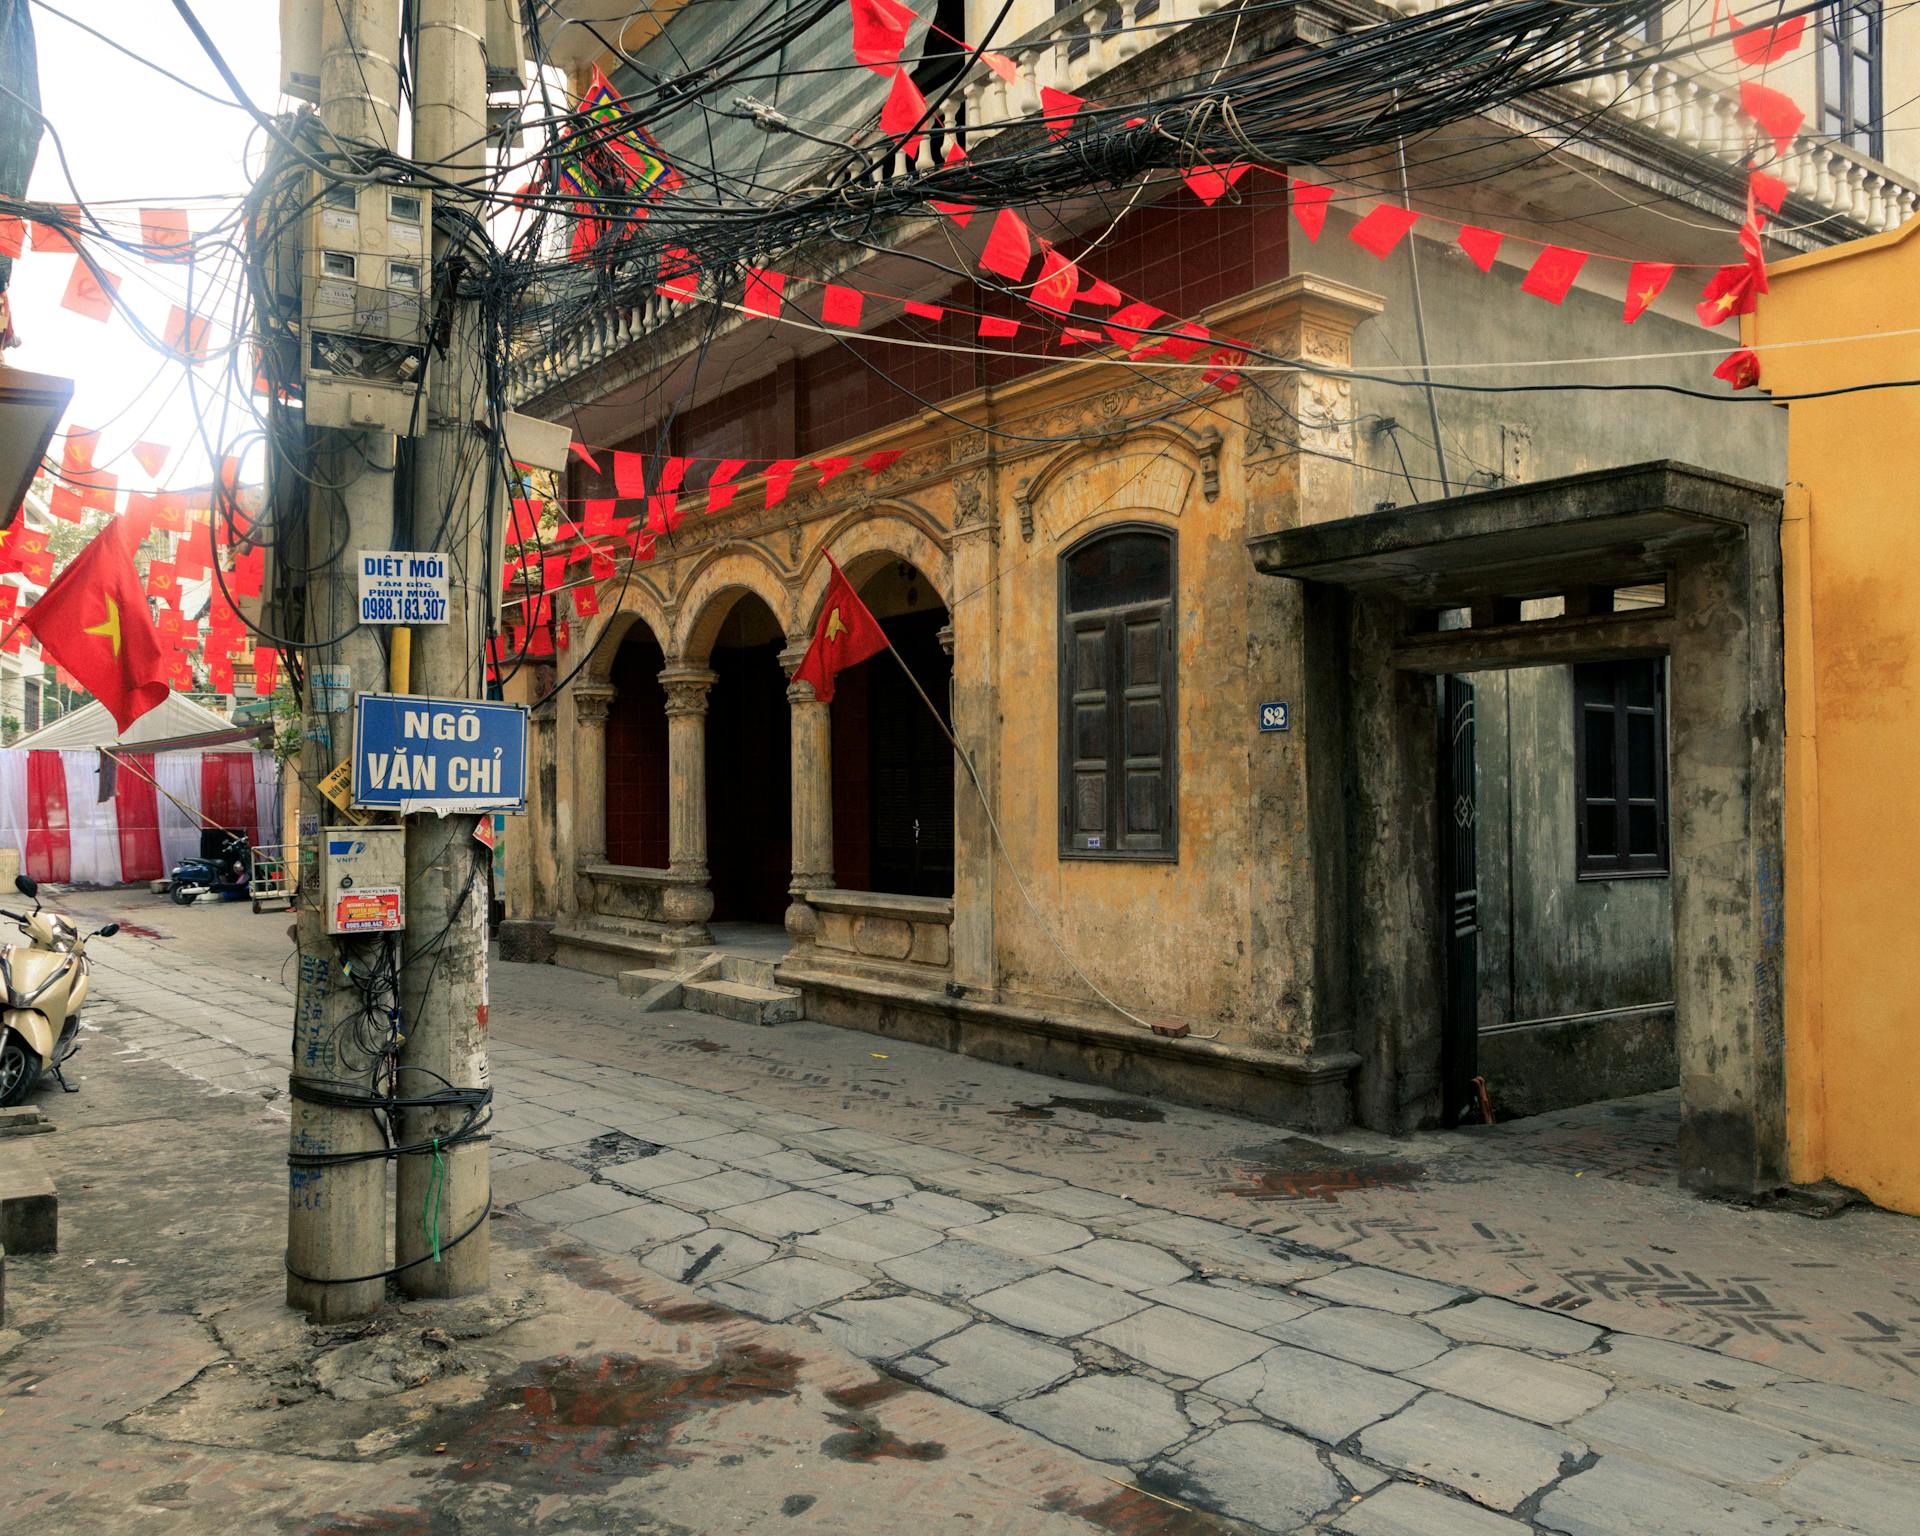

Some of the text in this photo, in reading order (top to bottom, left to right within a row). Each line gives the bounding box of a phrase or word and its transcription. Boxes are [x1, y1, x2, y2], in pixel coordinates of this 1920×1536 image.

[364, 554, 443, 578] DIỆT MỐI
[368, 589, 403, 597] PHUN
[362, 597, 446, 620] 0988.183.307
[404, 708, 481, 742] NGÕ
[1263, 706, 1286, 727] 82
[367, 746, 503, 794] VĂN CHỈ
